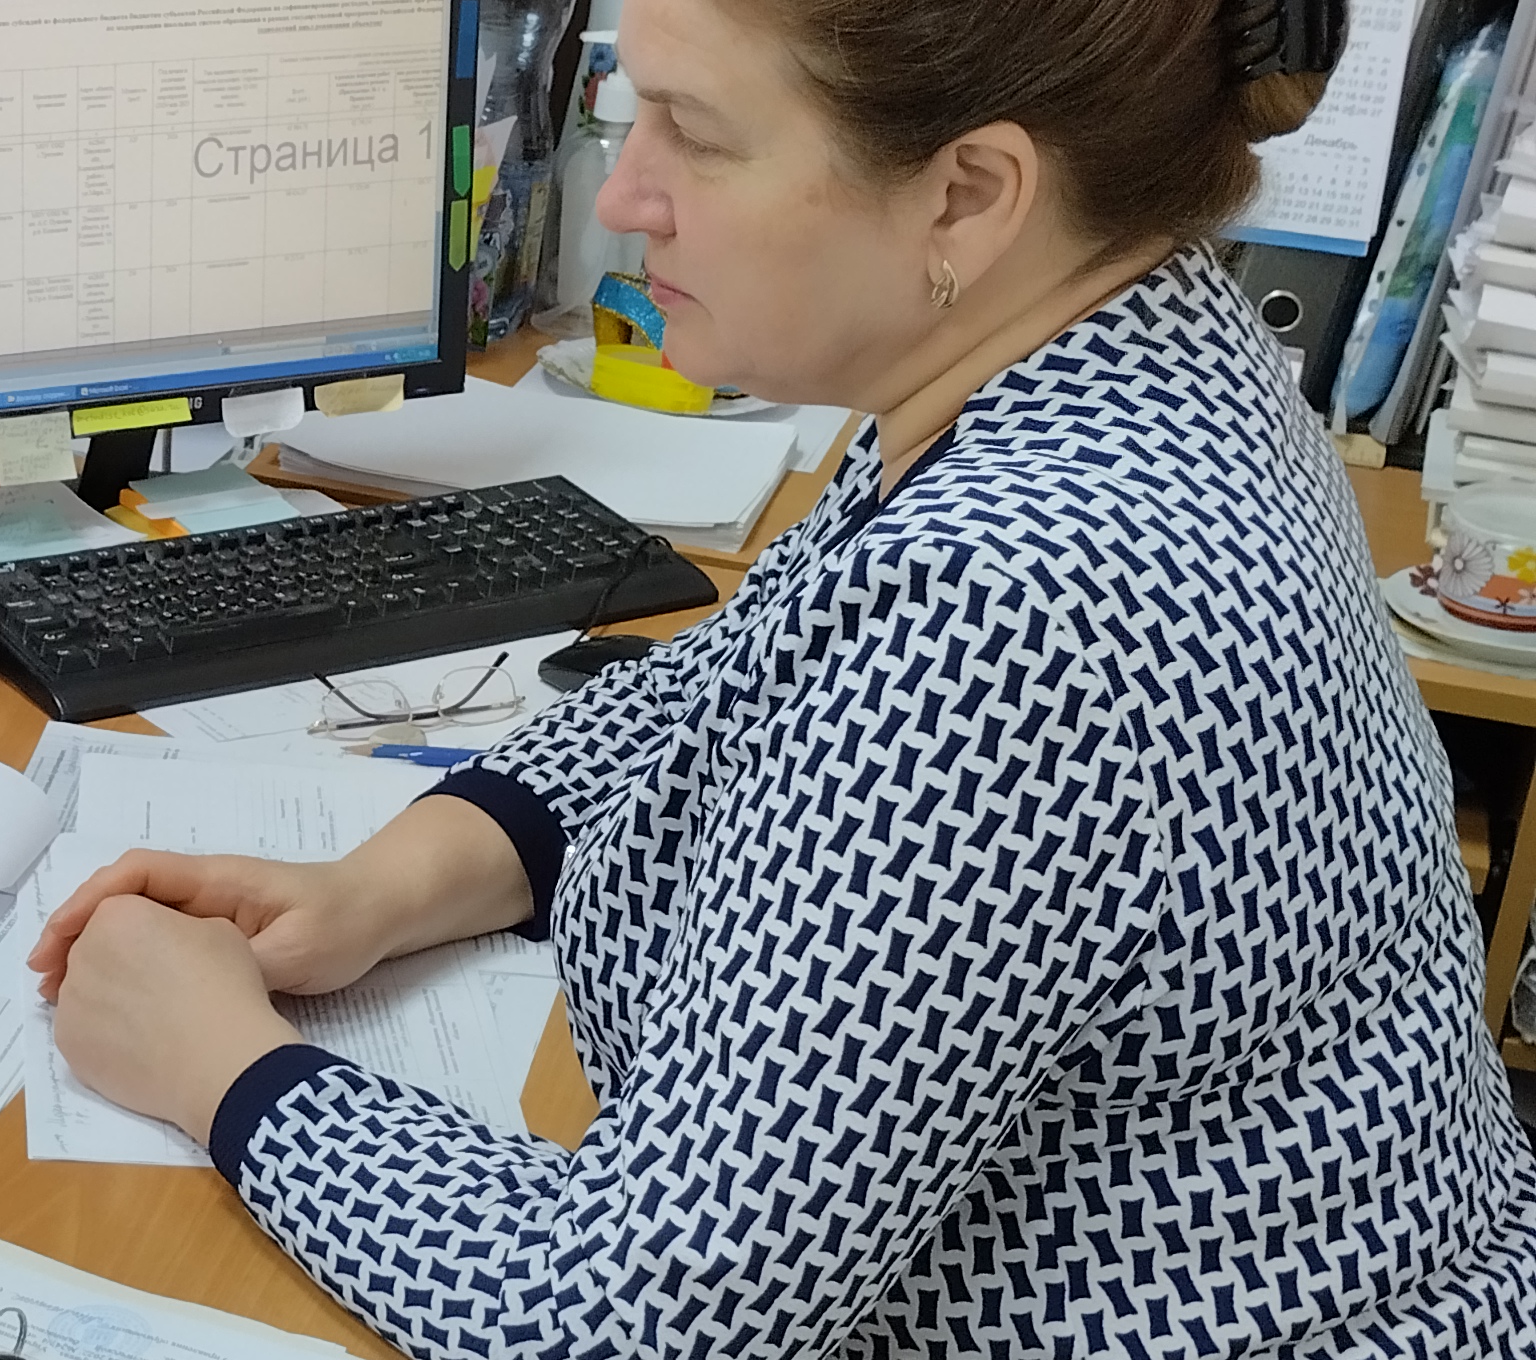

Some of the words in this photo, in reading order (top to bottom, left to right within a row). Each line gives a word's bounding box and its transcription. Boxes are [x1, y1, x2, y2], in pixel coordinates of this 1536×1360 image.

[193, 132, 399, 185] Страница
[417, 119, 433, 160] 1
[1304, 134, 1359, 152] Декабрь
